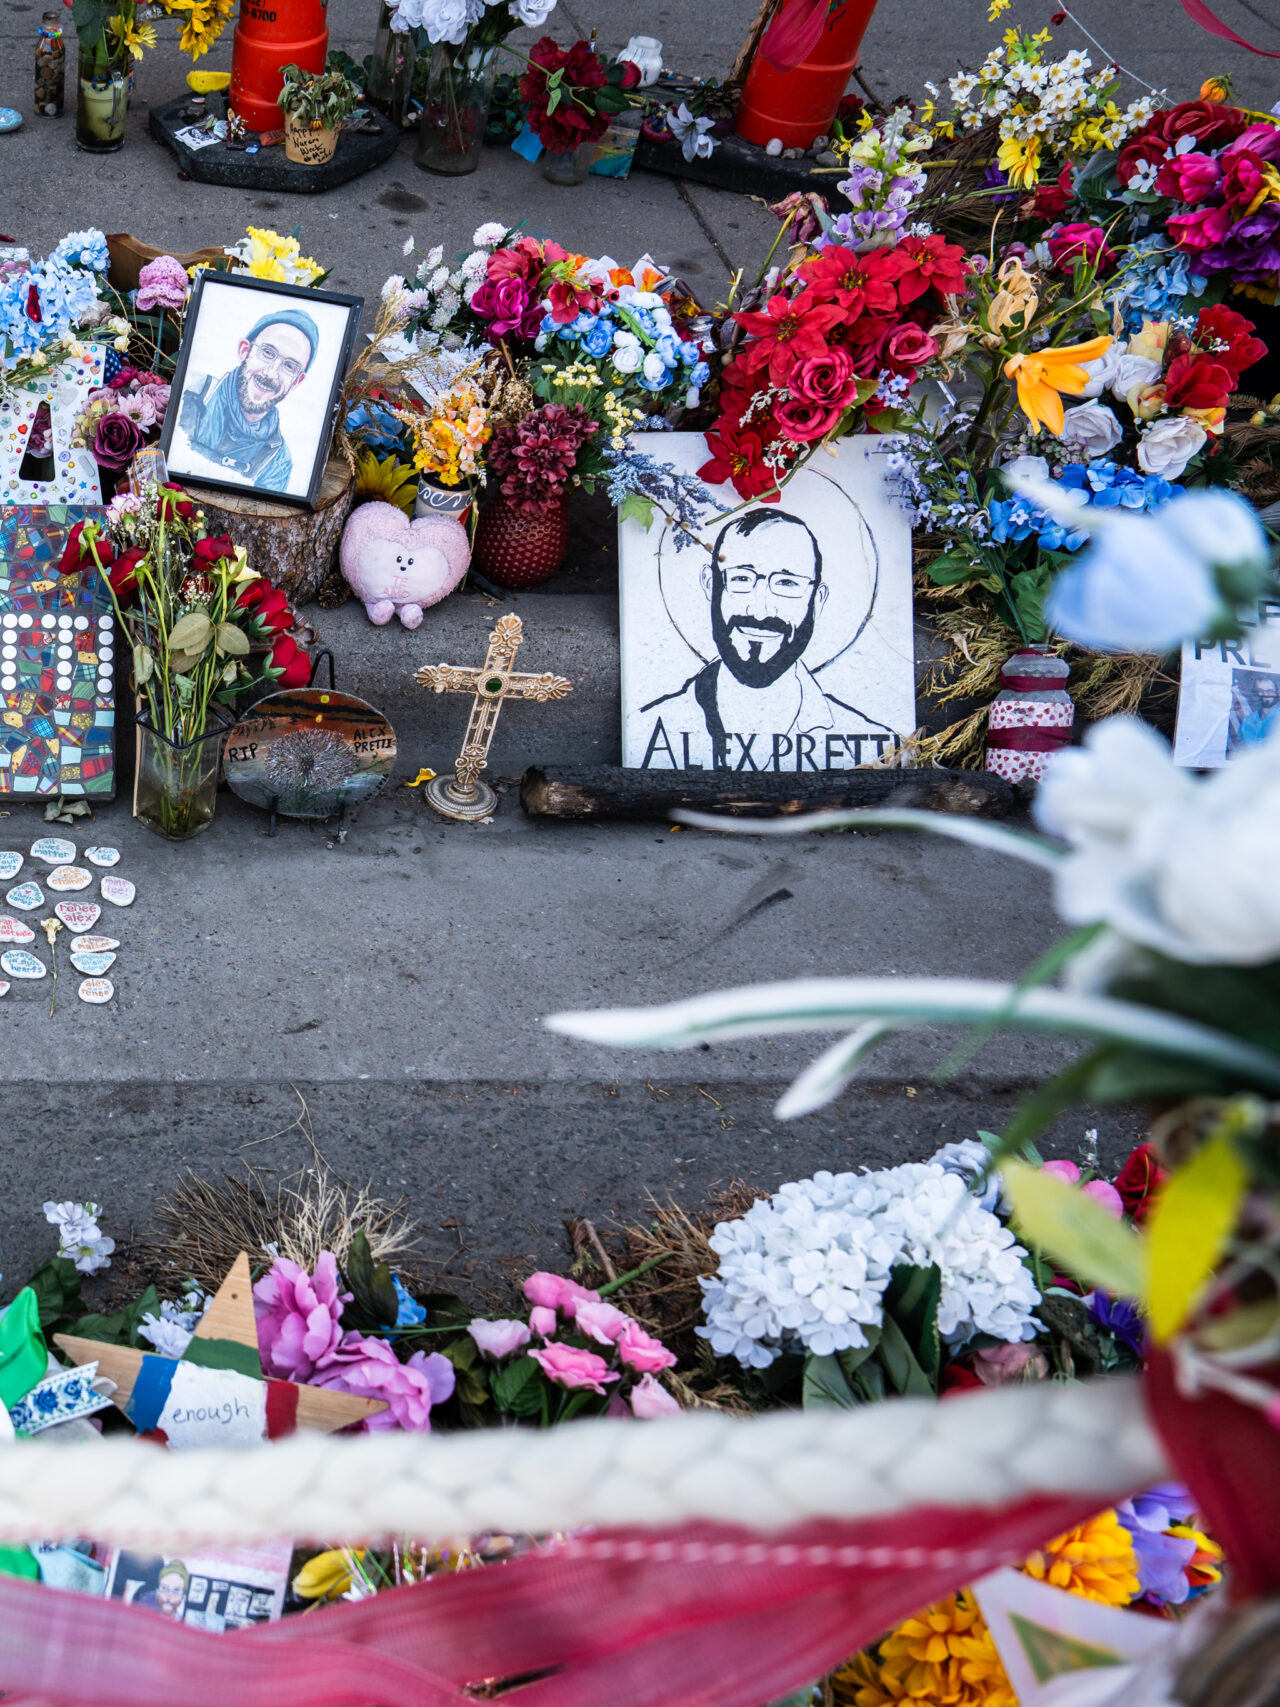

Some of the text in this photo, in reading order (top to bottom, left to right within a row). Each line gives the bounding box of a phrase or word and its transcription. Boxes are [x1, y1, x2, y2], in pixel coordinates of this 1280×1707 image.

[229, 743, 259, 763] RIP
[640, 716, 760, 772] ALEX
[172, 1398, 250, 1425] enough
